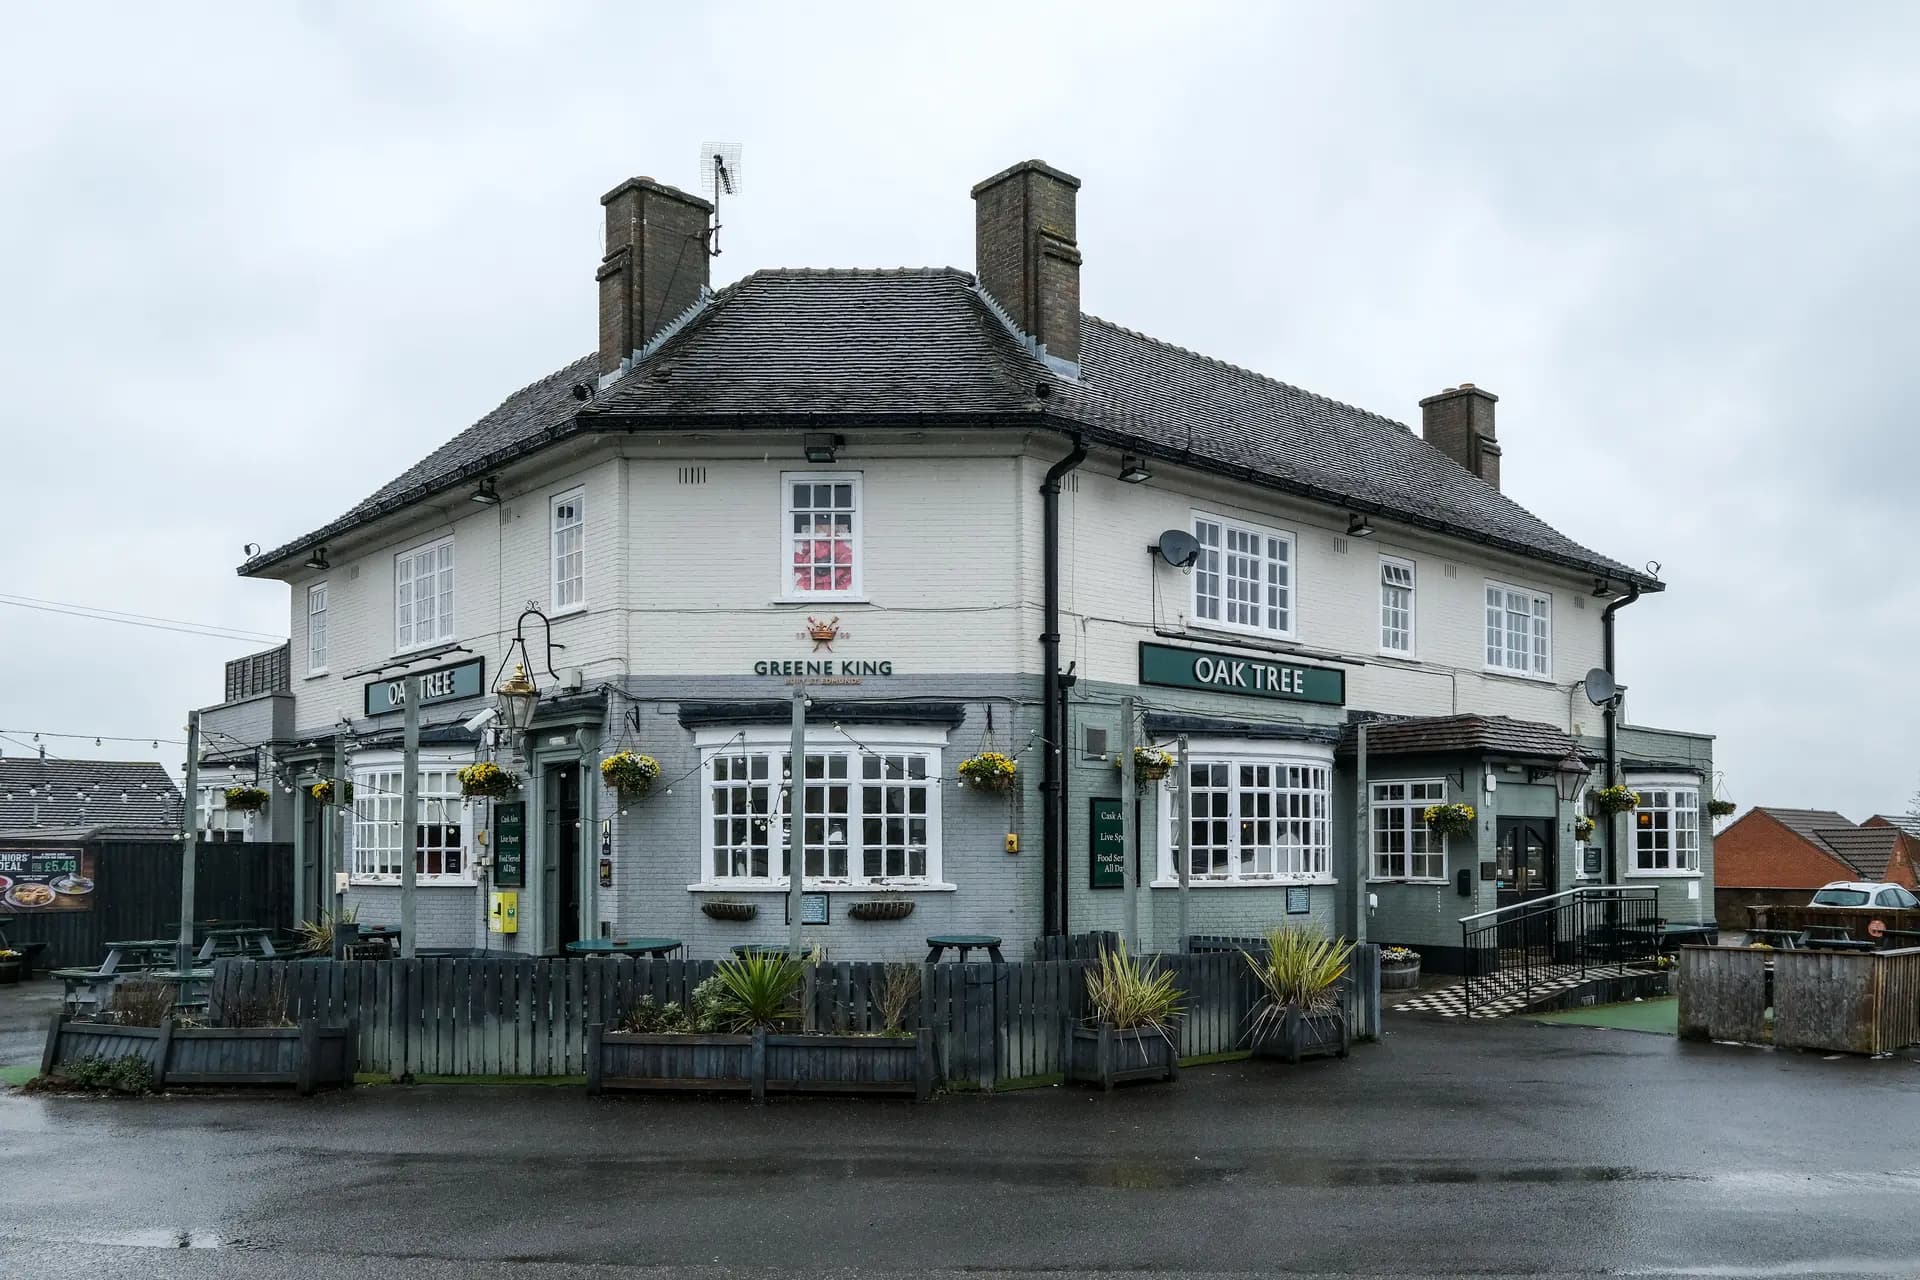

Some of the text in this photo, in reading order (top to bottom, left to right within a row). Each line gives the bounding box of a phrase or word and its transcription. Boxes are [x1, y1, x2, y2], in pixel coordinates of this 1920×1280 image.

[754, 661, 892, 676] GREENE KING
[1195, 657, 1304, 694] OAK TREE
[388, 671, 452, 705] OA TREE
[1101, 811, 1116, 820] Cask
[1101, 832, 1114, 841] Live
[1097, 853, 1124, 862] Food Ser
[44, 860, 77, 872] £5.49
[1104, 863, 1114, 872] All
